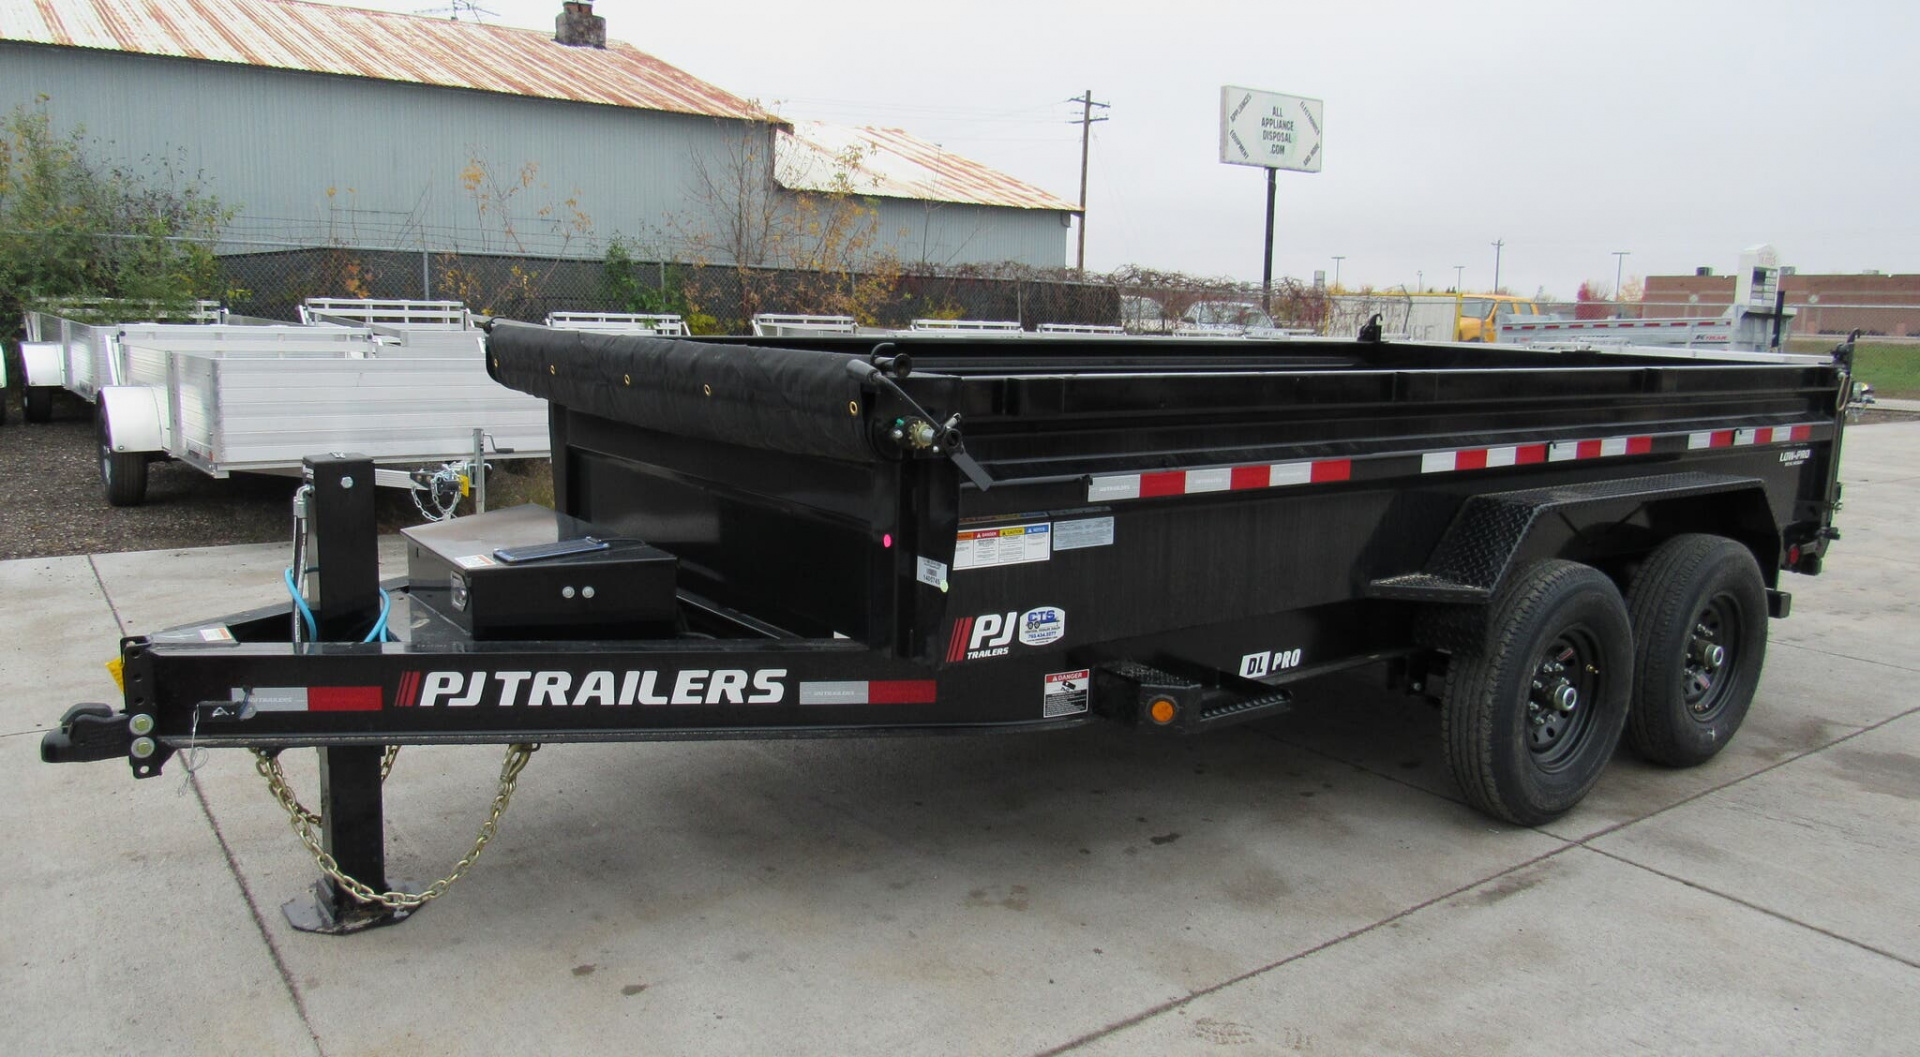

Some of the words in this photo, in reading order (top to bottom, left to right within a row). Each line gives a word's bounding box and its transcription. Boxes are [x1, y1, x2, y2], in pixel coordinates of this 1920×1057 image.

[1272, 106, 1283, 118] ALL
[1261, 117, 1294, 132] APPLIANCE
[1262, 130, 1292, 144] DISPOSAL
[1028, 610, 1056, 622] CTS
[969, 611, 1018, 650] PJ
[967, 646, 1010, 660] TRAILERS
[1247, 656, 1264, 675] DL
[1271, 648, 1302, 671] PRO
[1058, 672, 1083, 681] DANGER
[420, 671, 487, 707] PJ
[494, 669, 788, 707] TRAILERS
